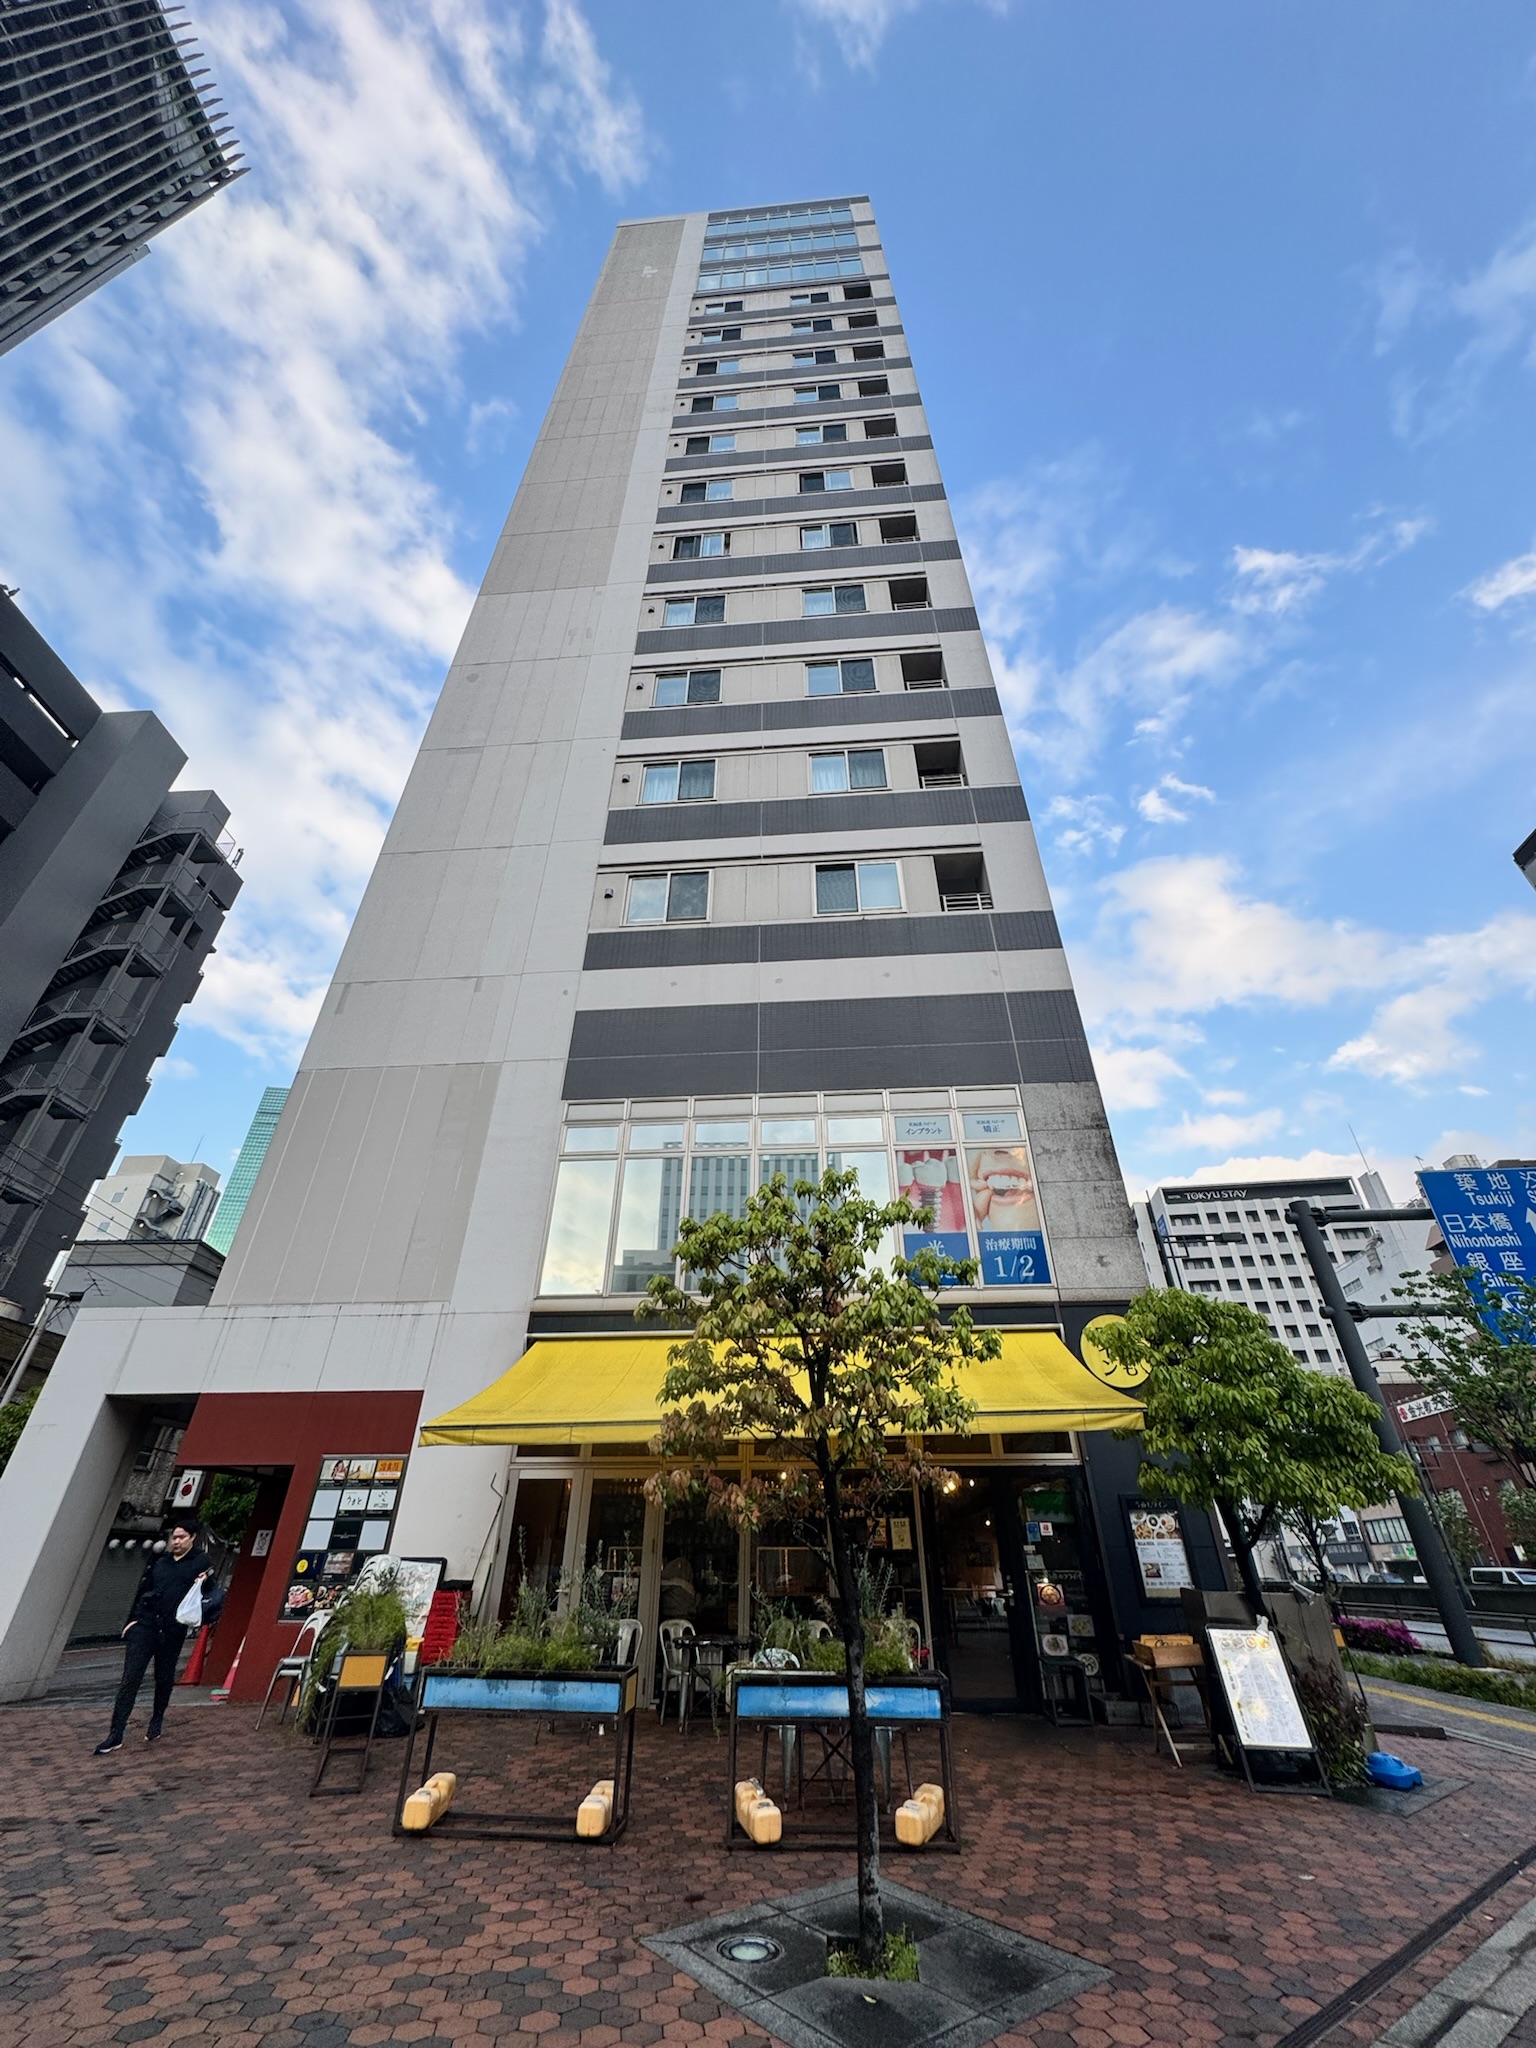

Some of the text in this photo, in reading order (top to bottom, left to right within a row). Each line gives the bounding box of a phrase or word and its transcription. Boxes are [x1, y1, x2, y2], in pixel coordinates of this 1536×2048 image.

[905, 1126, 943, 1135] インプラント
[983, 1124, 1000, 1133] 矯正
[1453, 1172, 1511, 1191] 築地
[1184, 1190, 1220, 1200] TOKYU
[1220, 1189, 1247, 1198] STAY
[1464, 1191, 1516, 1207] Tsukiji
[1442, 1212, 1513, 1233] 日本橋
[985, 1237, 1037, 1251] 治療期間
[1448, 1232, 1523, 1248] Nihonbashi
[994, 1254, 1035, 1278] 1/2
[1465, 1251, 1527, 1272] 銀座
